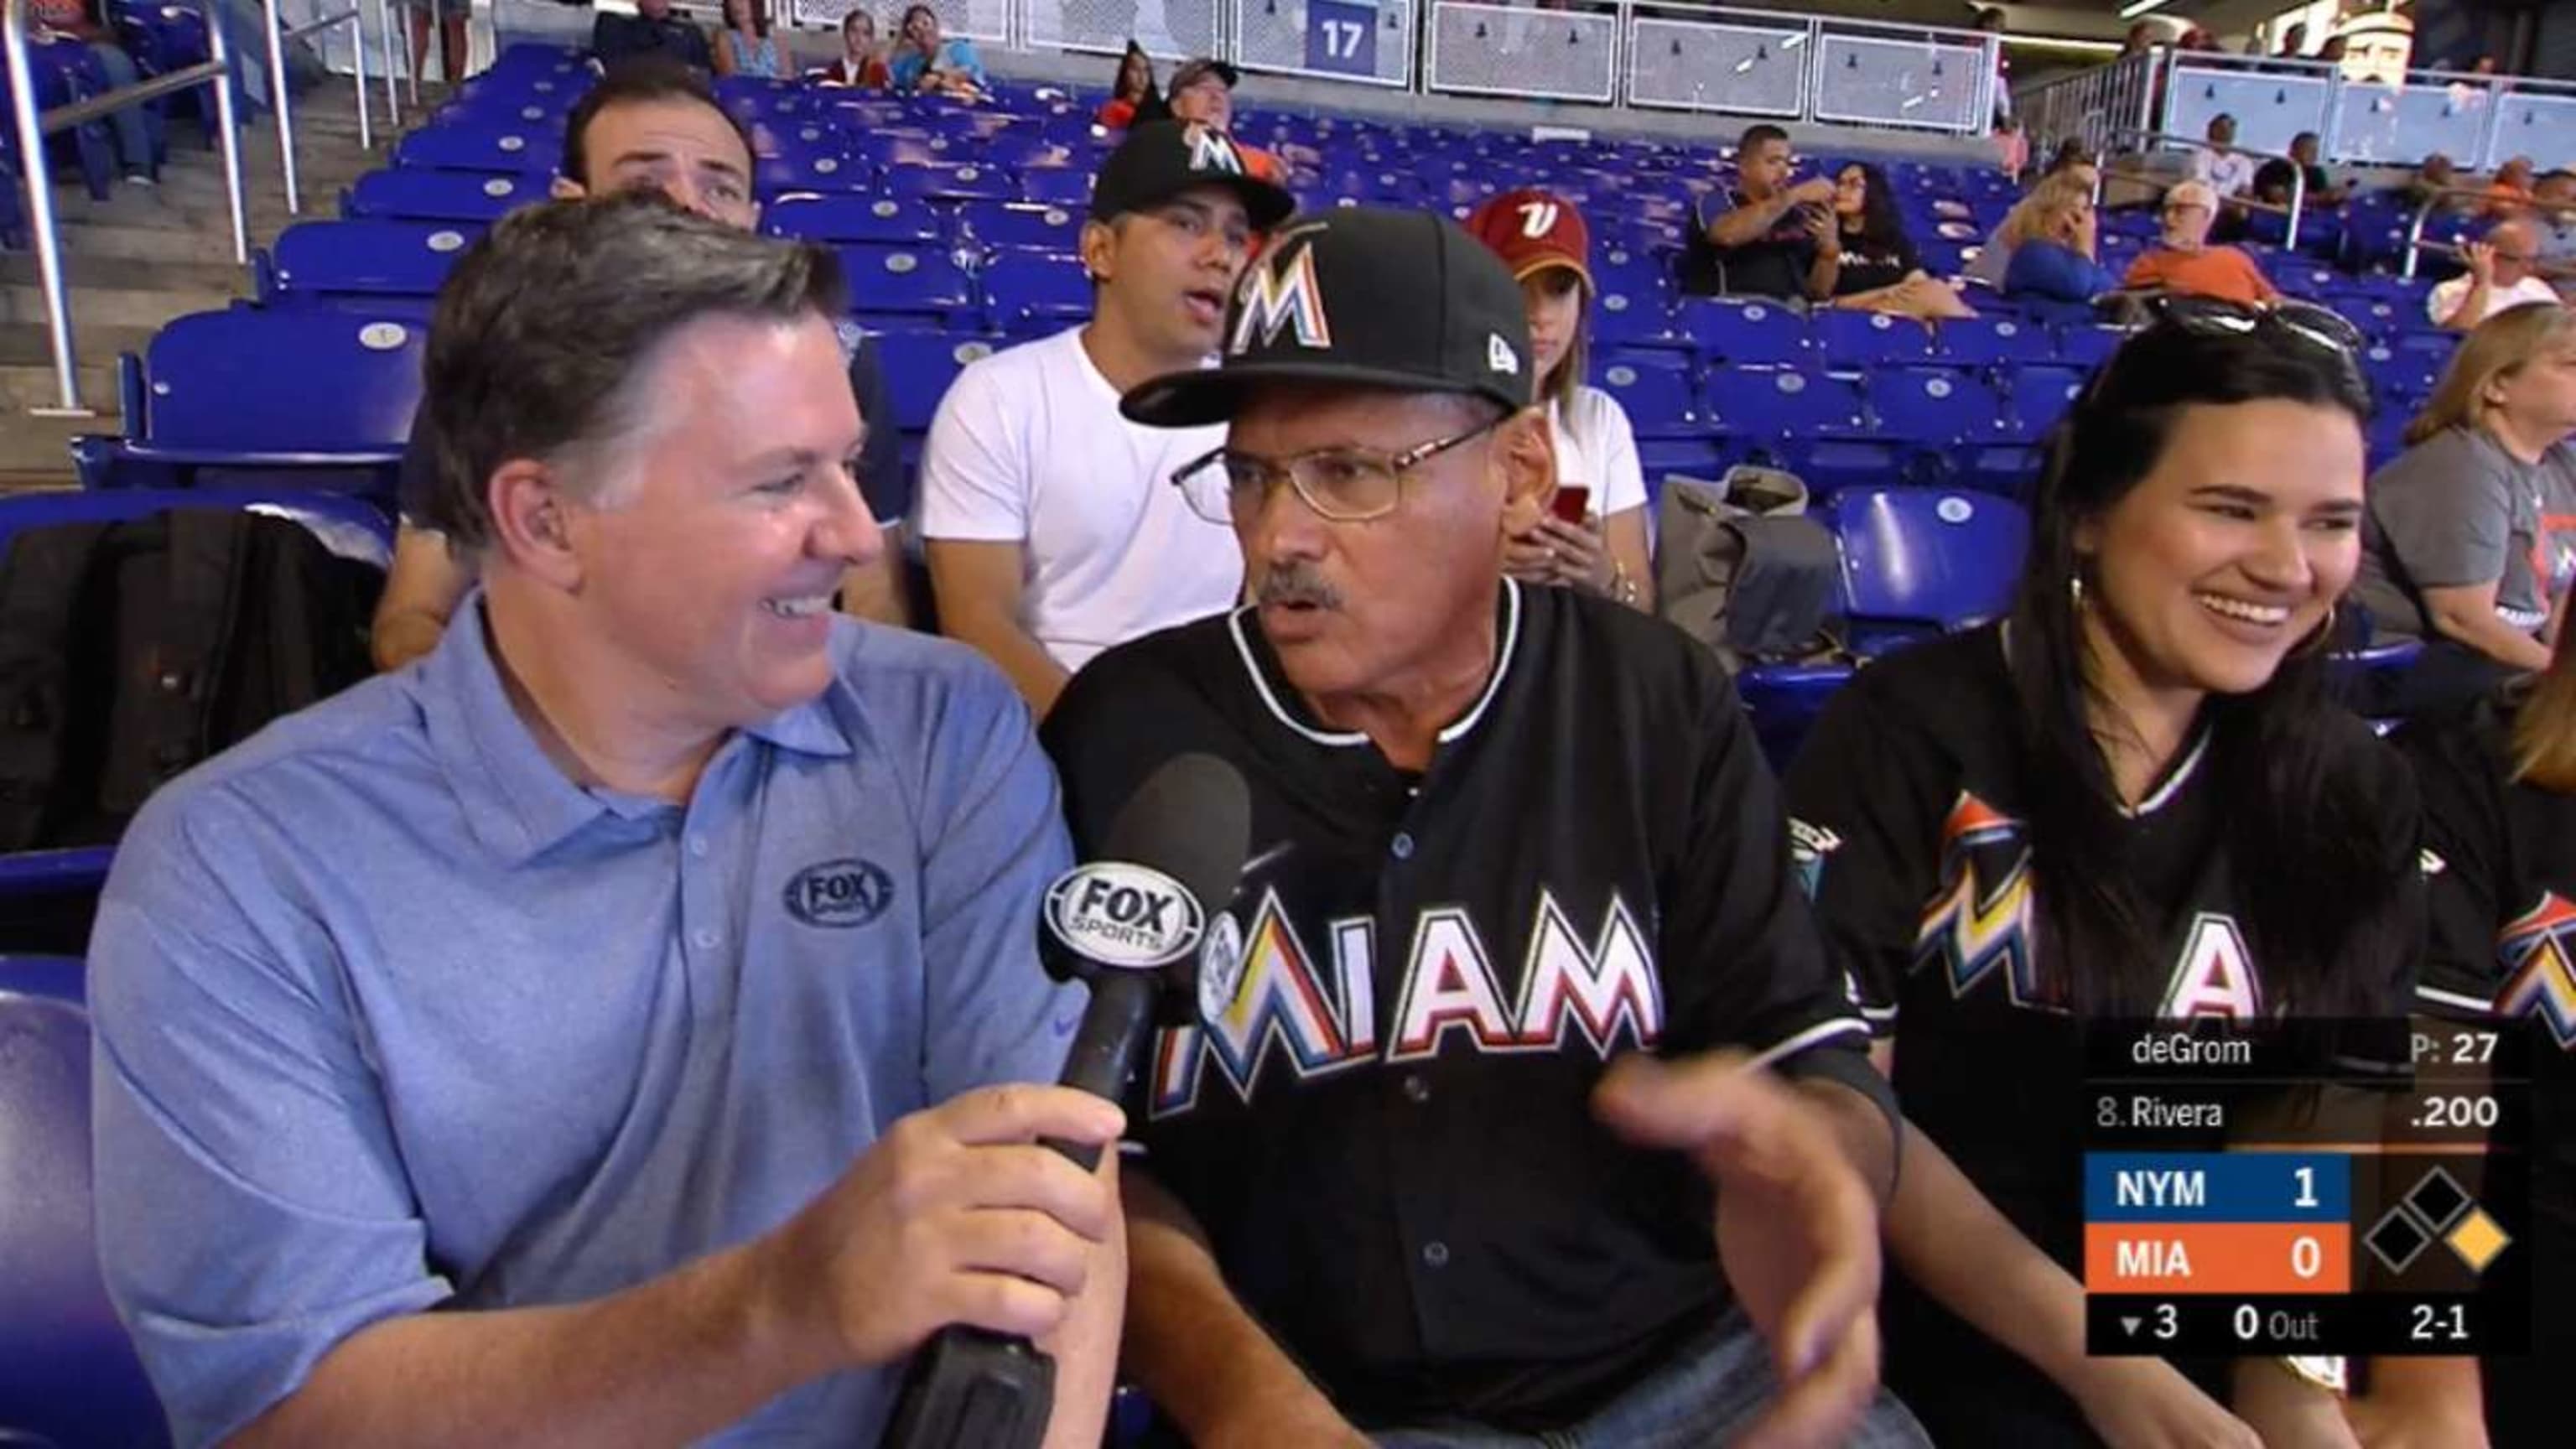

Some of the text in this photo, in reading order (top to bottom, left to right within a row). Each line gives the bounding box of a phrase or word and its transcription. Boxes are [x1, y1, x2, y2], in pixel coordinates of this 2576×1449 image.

[1322, 20, 1363, 57] 17
[1229, 240, 1332, 356] M
[808, 873, 870, 907] FOX
[1078, 877, 1174, 934] FOX
[1068, 915, 1163, 952] SPORTS
[1150, 886, 1666, 1120] MIAM
